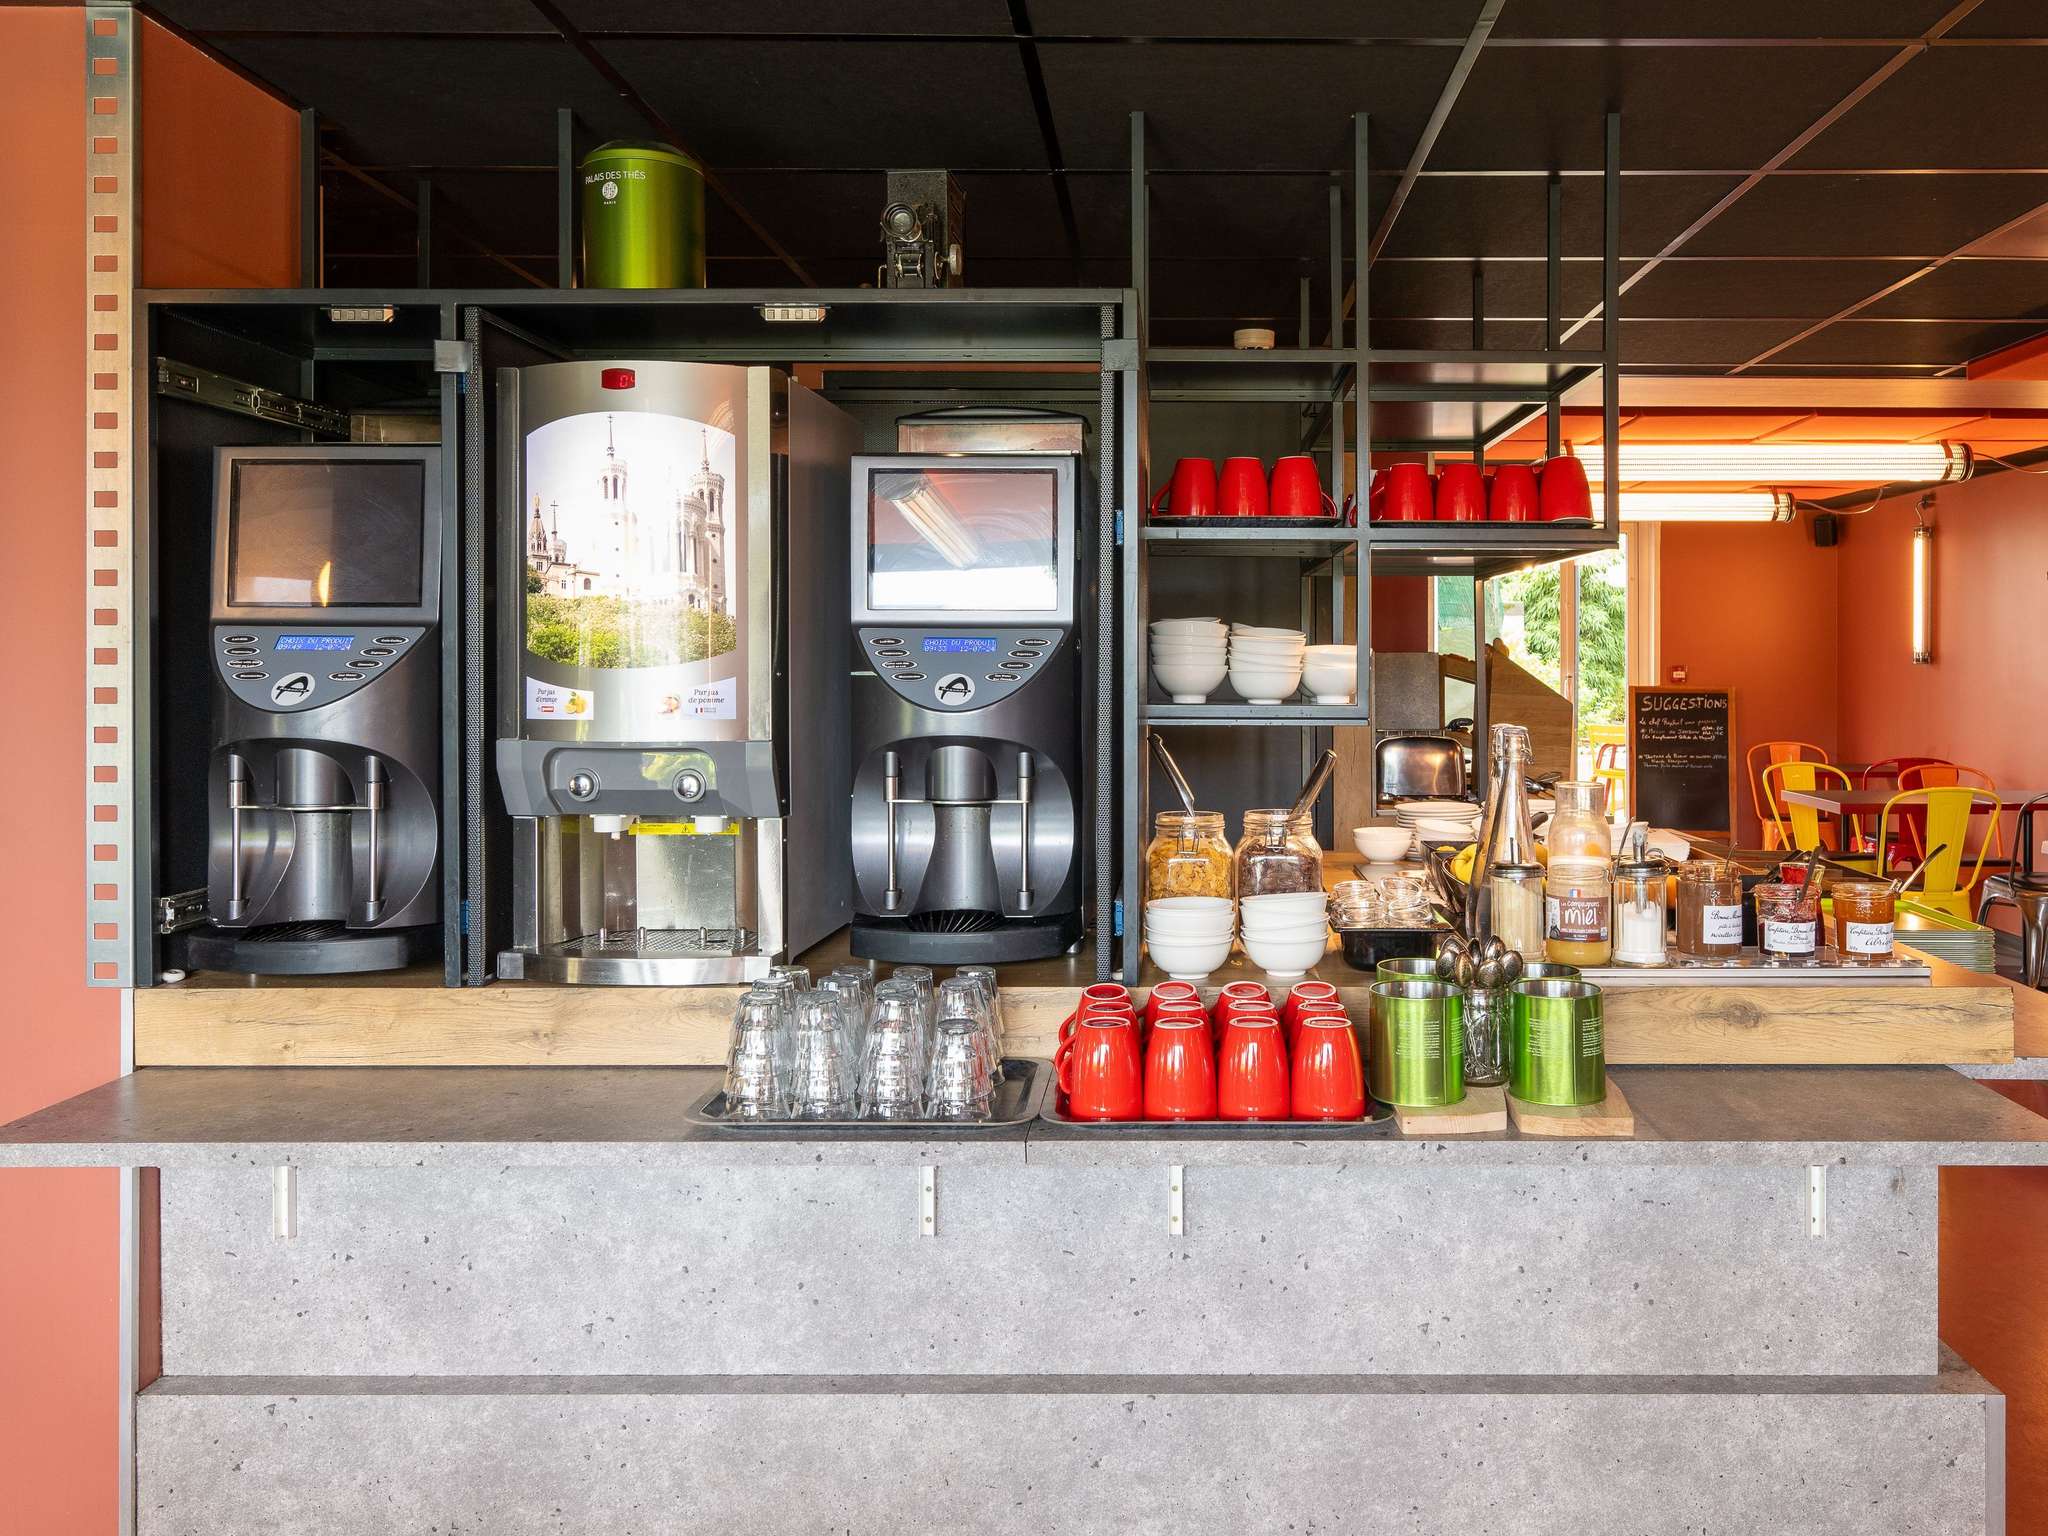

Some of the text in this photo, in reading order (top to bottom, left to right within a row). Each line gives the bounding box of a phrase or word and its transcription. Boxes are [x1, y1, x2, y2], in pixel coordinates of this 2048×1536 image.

[585, 173, 605, 185] PALAIS
[605, 171, 622, 180] DES
[280, 636, 354, 644] CHOIX DU PRODUIT
[694, 688, 719, 697] Pur jus
[1564, 907, 1598, 926] miel
